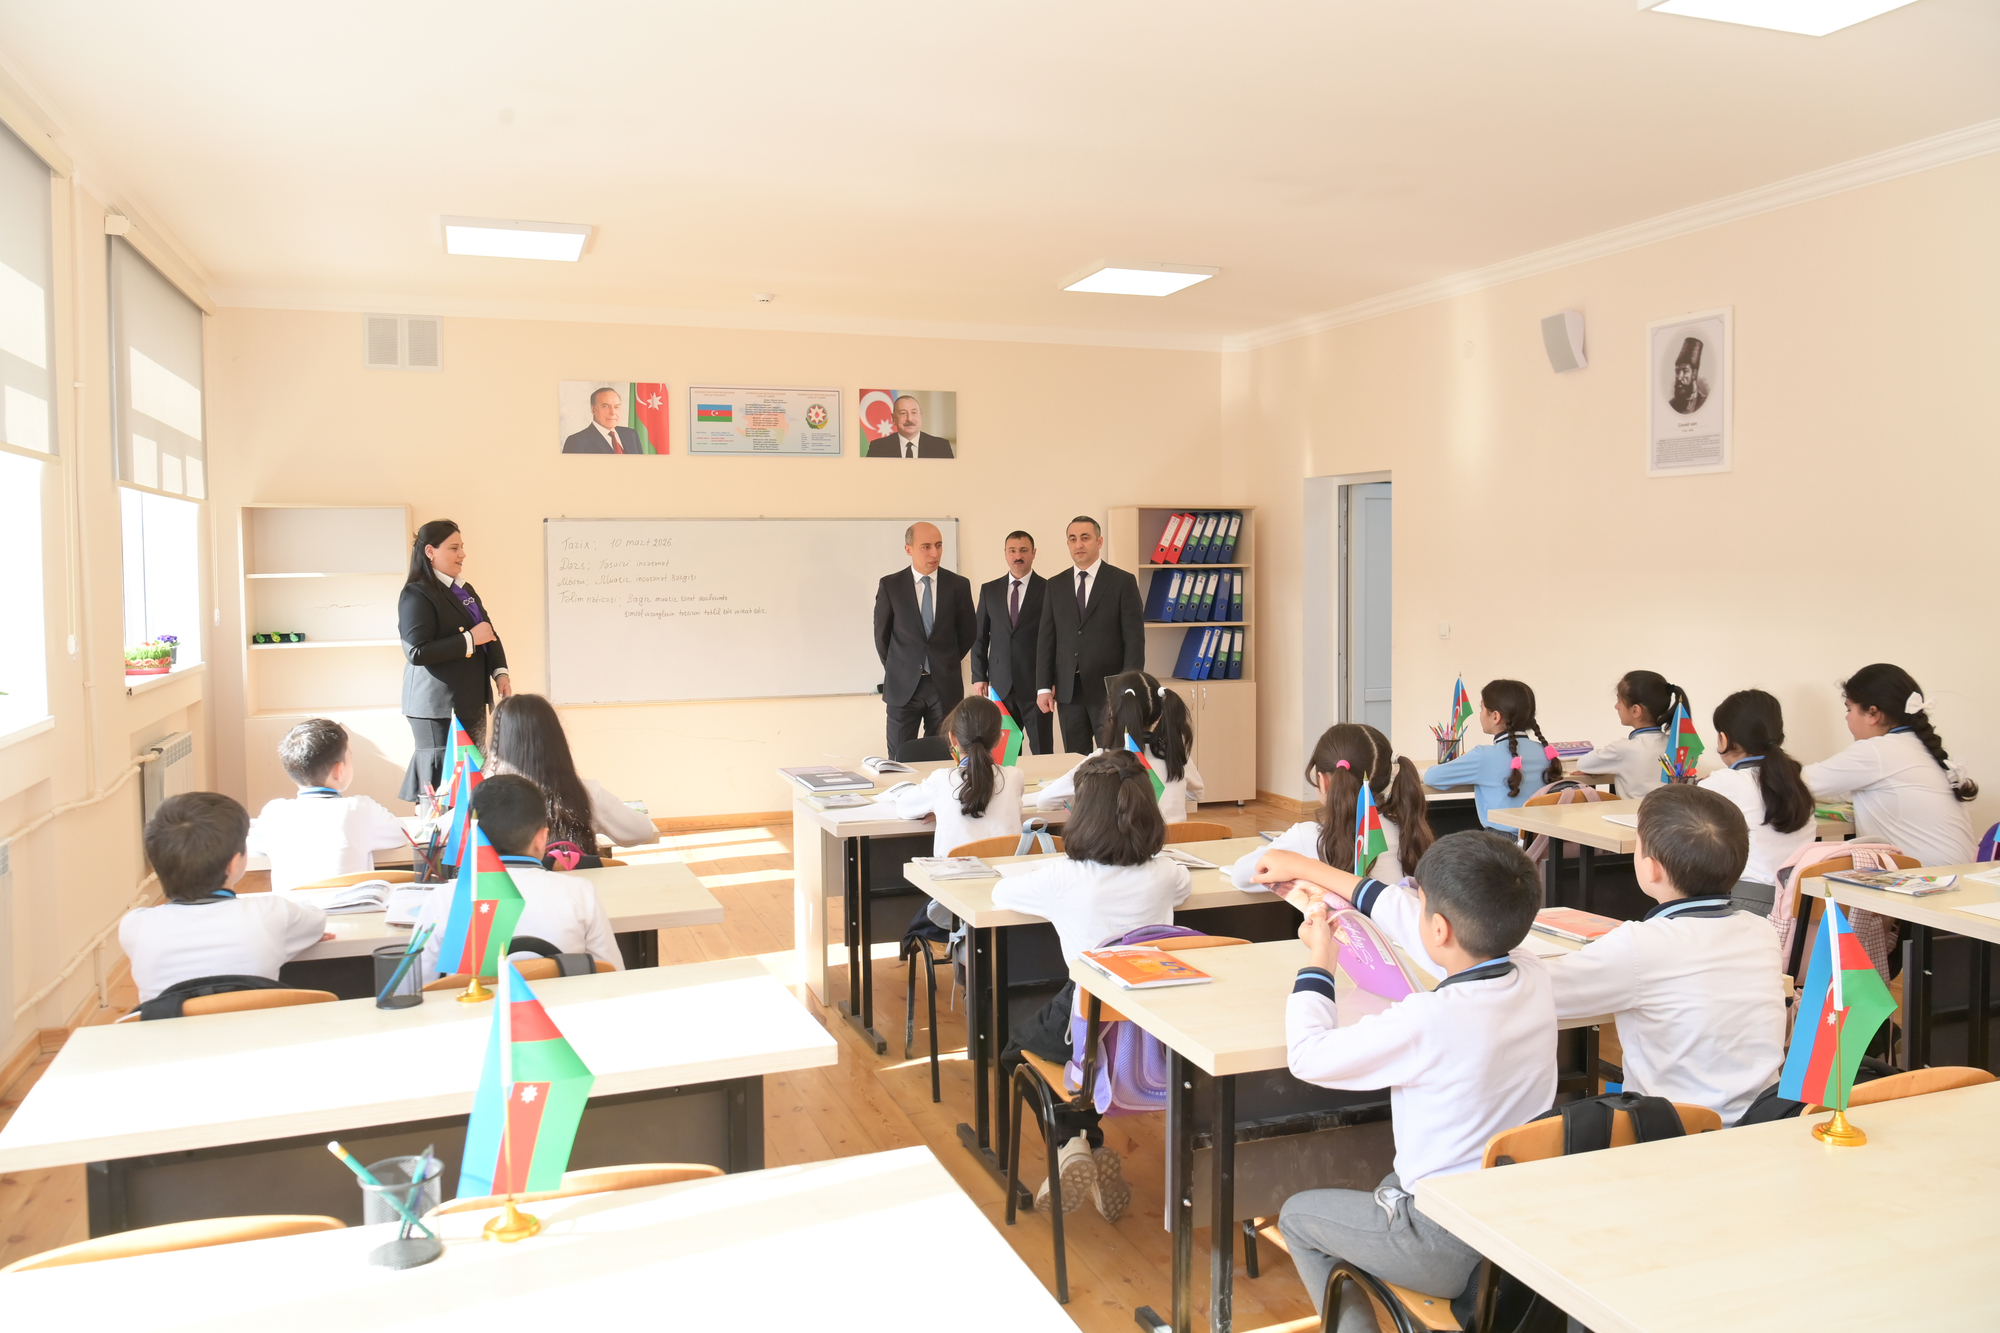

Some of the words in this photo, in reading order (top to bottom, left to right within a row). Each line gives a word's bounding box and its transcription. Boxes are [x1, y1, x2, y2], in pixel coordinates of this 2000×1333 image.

[610, 538, 622, 548] 10
[625, 537, 651, 547] mart
[652, 537, 672, 547] 2026
